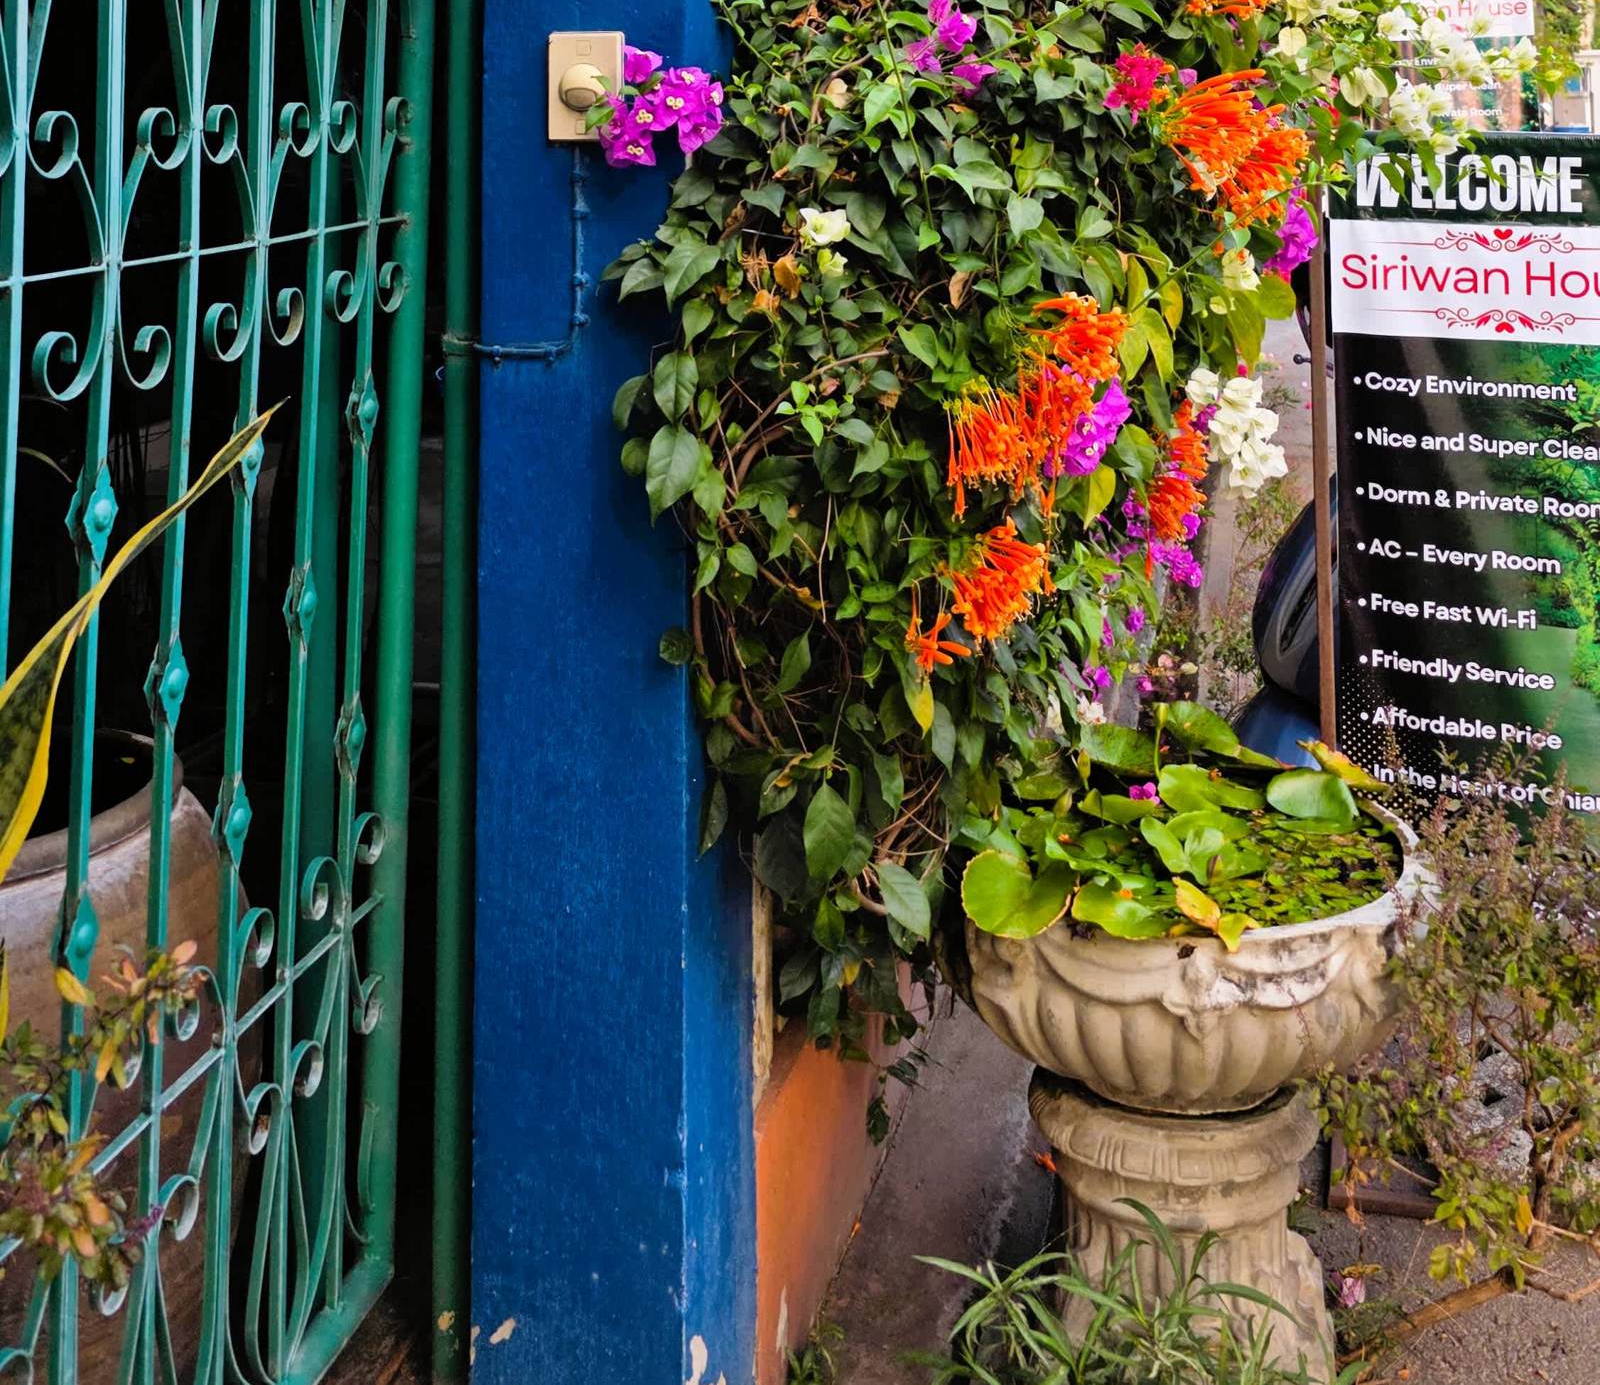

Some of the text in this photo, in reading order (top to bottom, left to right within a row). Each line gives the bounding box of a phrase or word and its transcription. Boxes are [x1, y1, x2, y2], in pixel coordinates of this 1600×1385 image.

[1457, 0, 1528, 18] Huse
[1356, 153, 1584, 213] WELCOME
[1342, 253, 1510, 295] Siriwan
[1365, 371, 1577, 402] Cozy Environment
[1367, 426, 1600, 461] Nice and Super Clea
[1368, 482, 1430, 507] Dorm
[1434, 489, 1451, 508] &
[1455, 489, 1539, 515] Private
[1369, 538, 1401, 559] AC
[1423, 543, 1488, 572] Every
[1491, 550, 1561, 574] Room
[1371, 593, 1537, 630] Free Fast Wi-Fi
[1371, 648, 1555, 690] Friendly Service
[1372, 706, 1563, 750] Affordable Price
[1373, 763, 1395, 783] In
[1510, 783, 1538, 803] of
